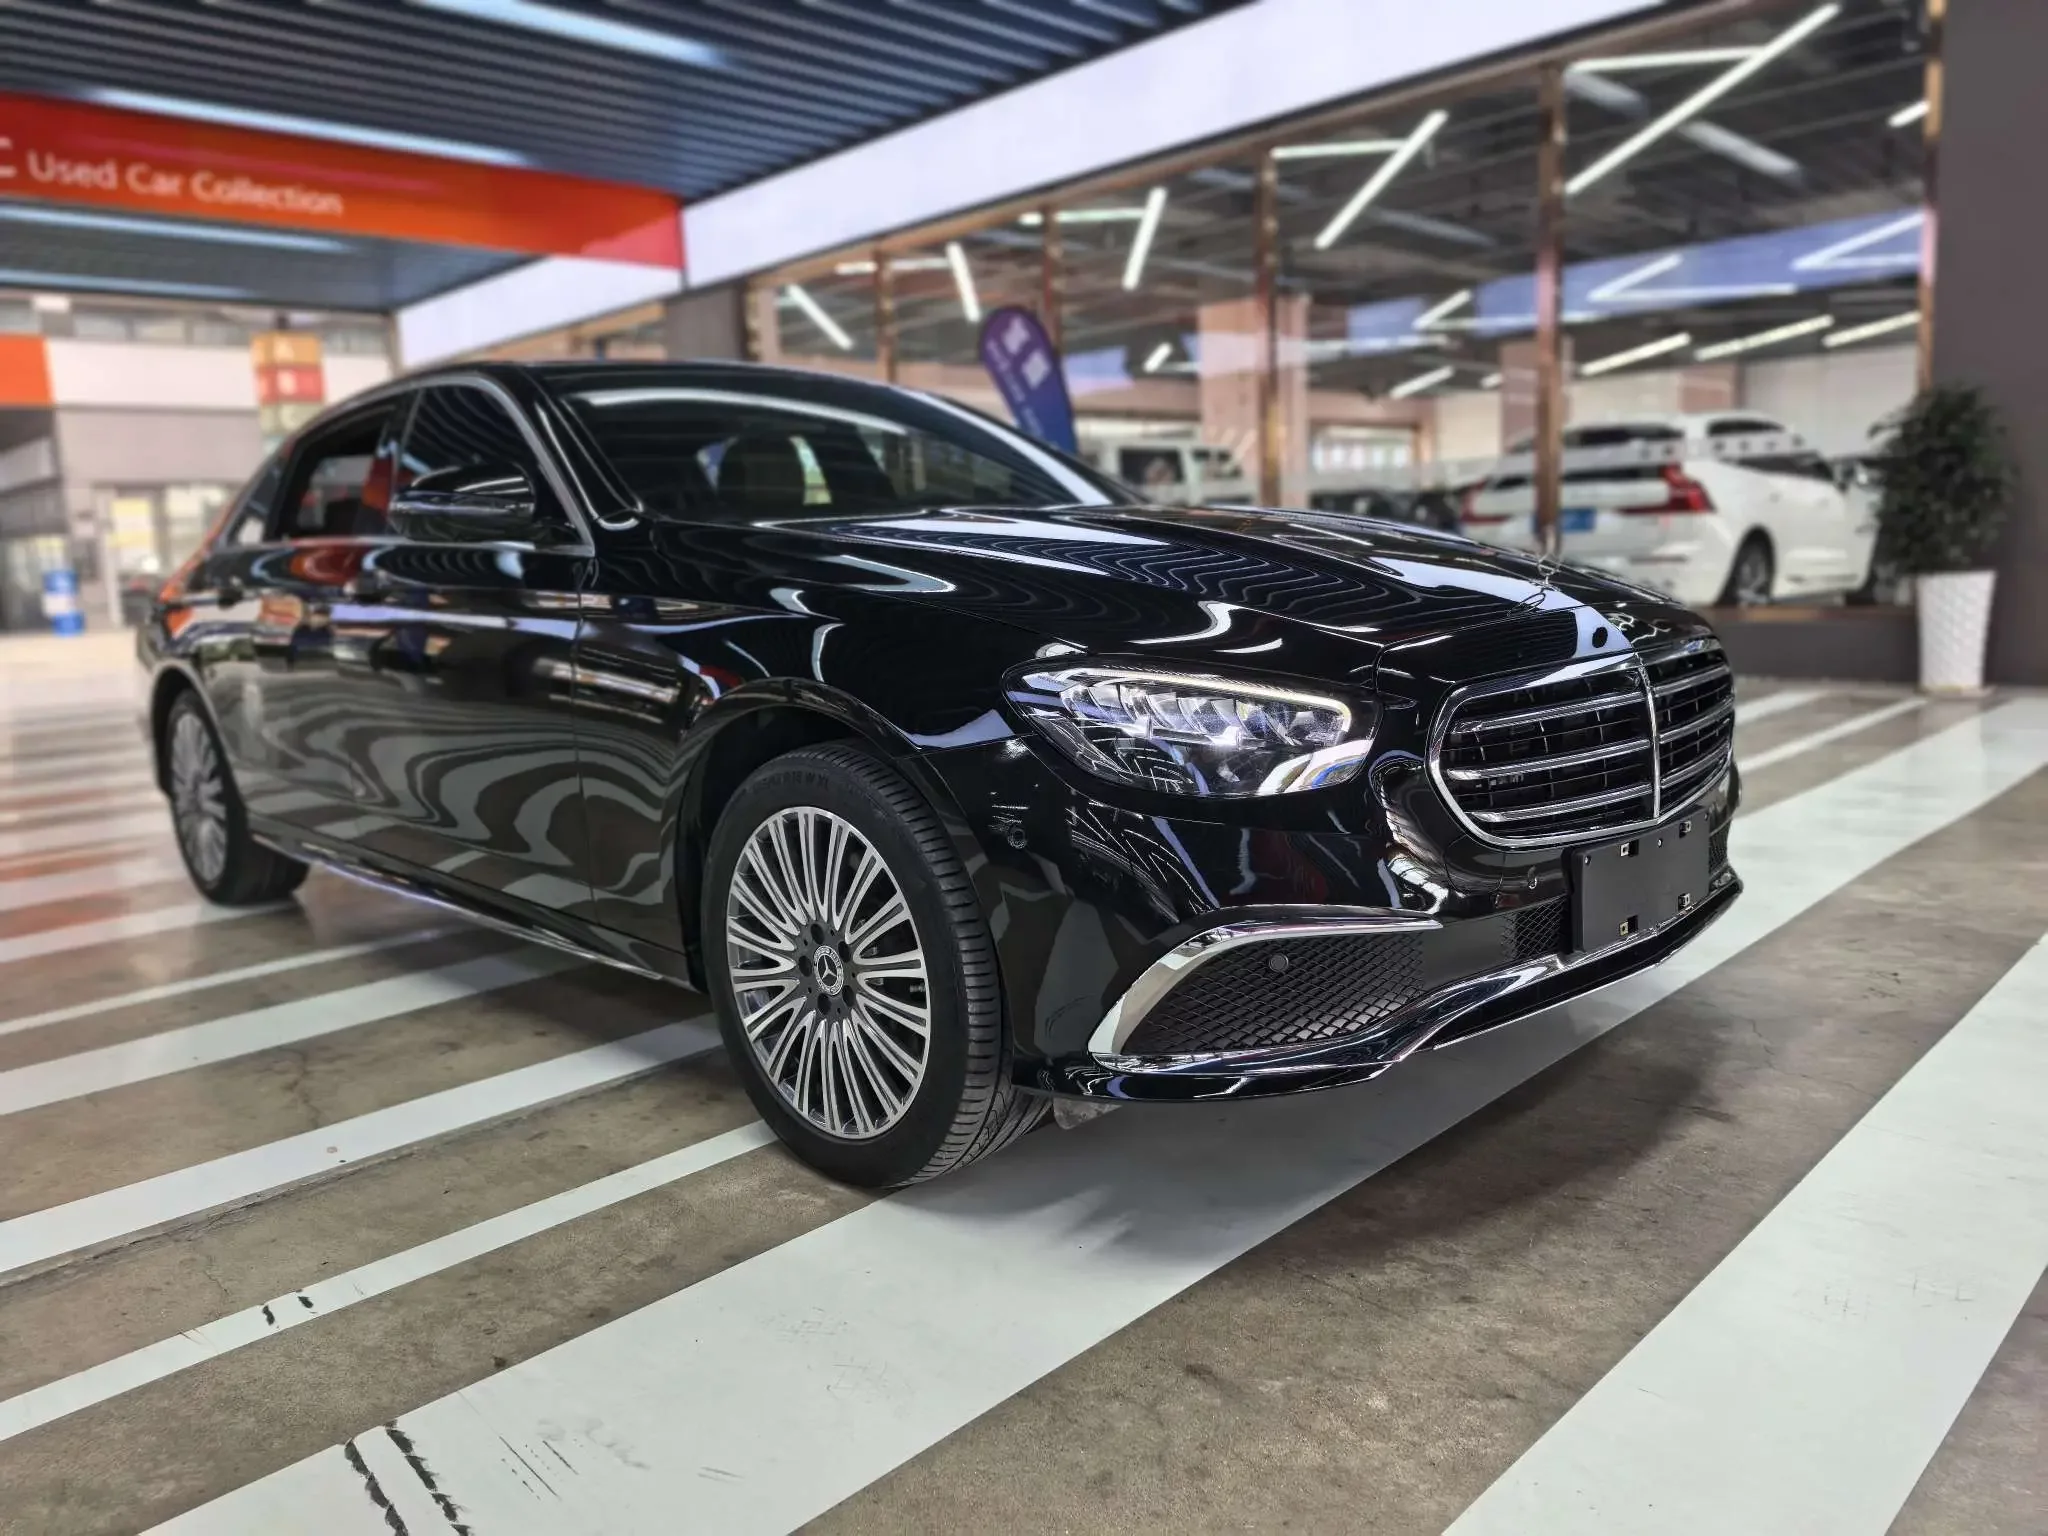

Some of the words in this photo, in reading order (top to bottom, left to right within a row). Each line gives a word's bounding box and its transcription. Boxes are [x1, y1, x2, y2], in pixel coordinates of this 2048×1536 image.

[26, 148, 118, 191] Used
[126, 163, 183, 197] Car
[190, 171, 344, 217] Collection
